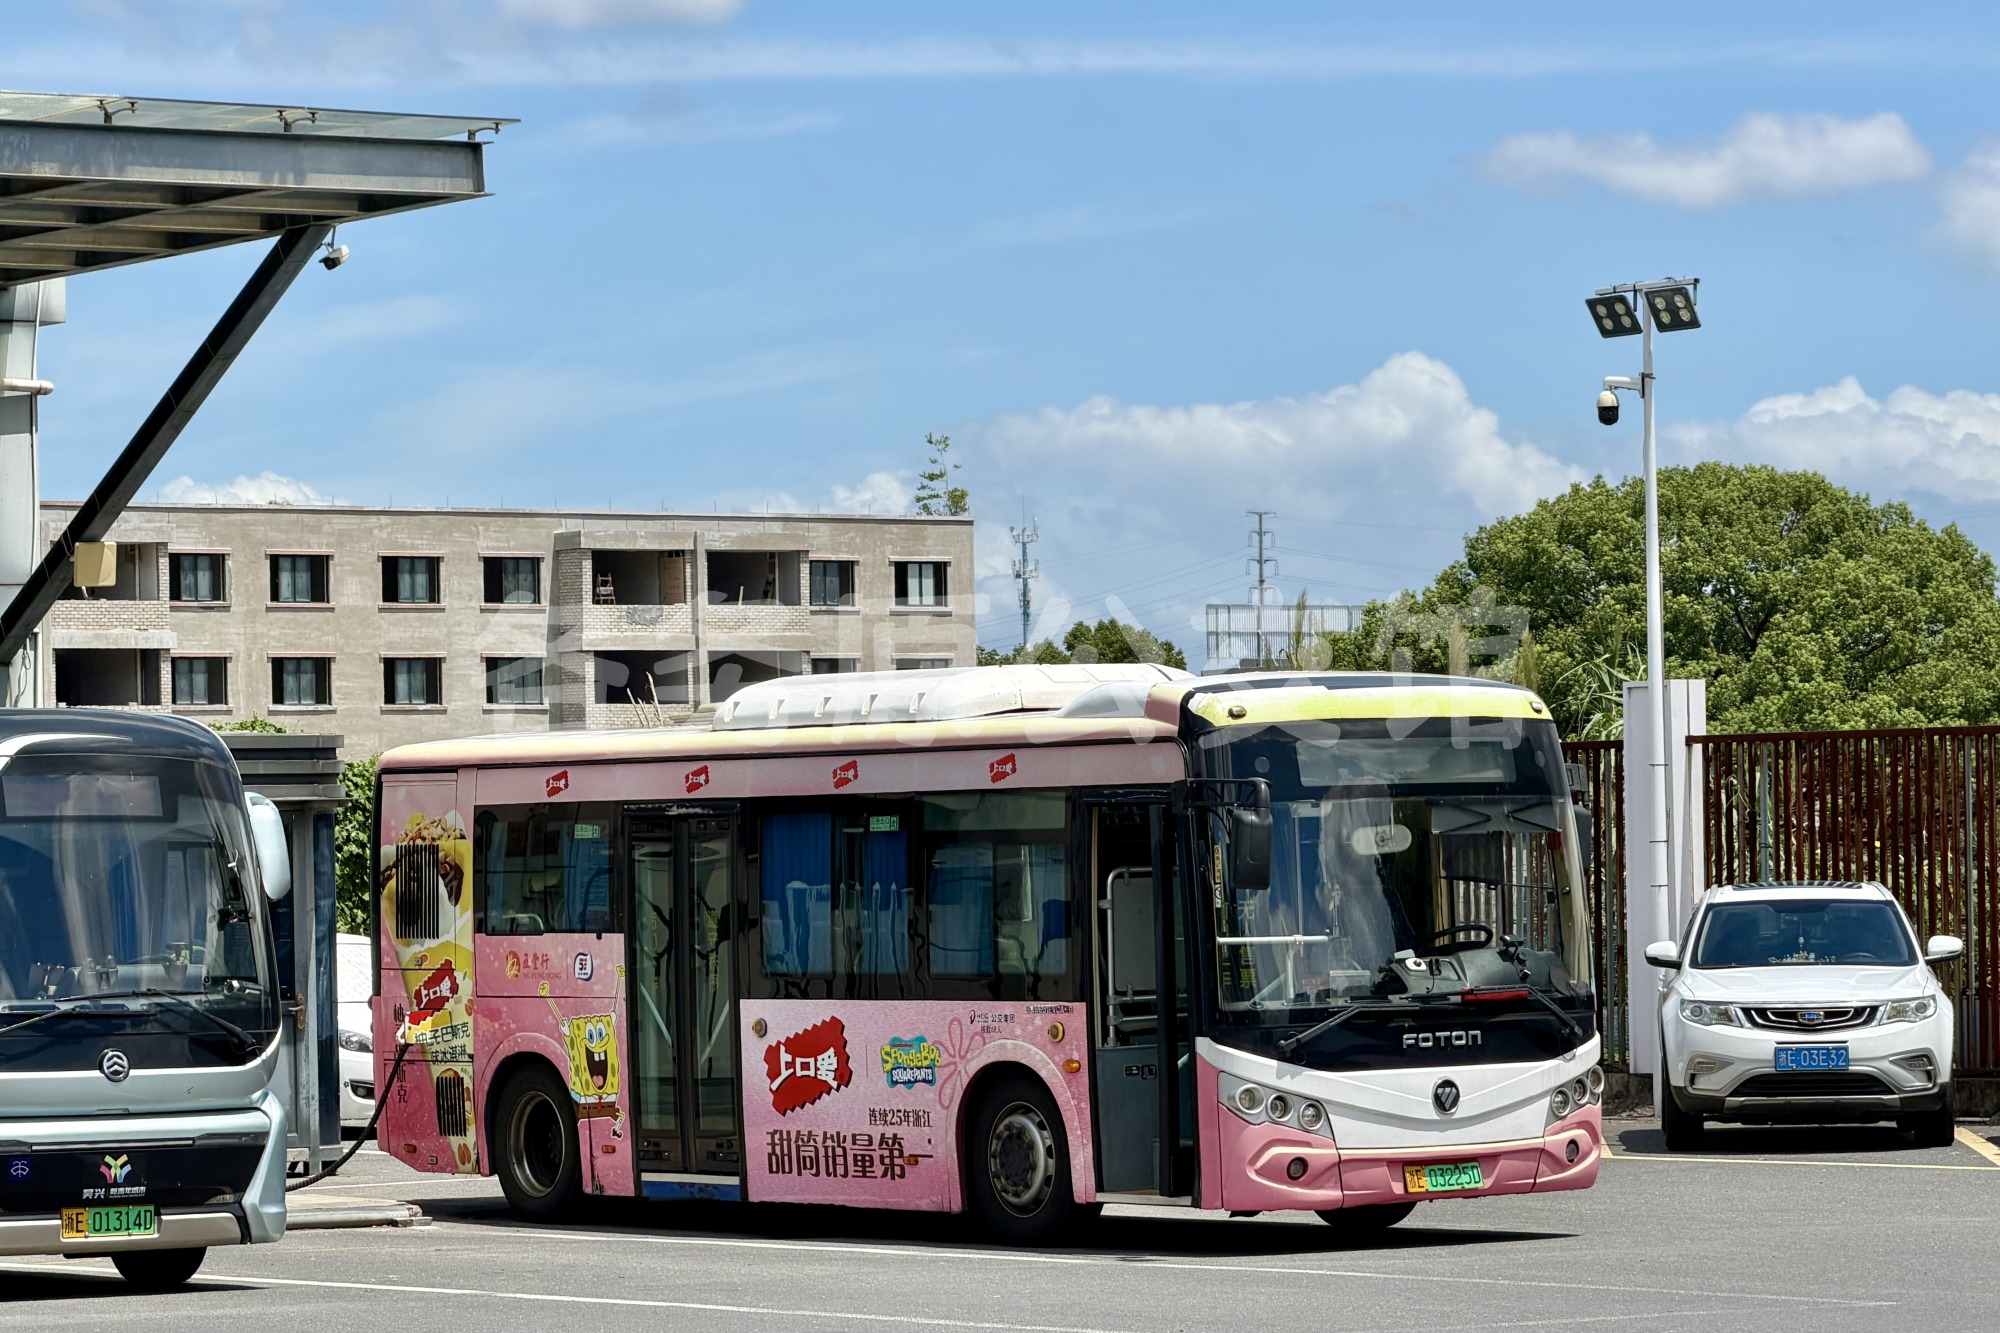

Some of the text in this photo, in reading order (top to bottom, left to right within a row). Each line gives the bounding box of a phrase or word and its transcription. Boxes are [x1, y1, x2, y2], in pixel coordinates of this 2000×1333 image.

[1402, 1030, 1482, 1049] FOTON
[770, 1045, 839, 1091] 上口爱
[892, 1068, 933, 1083] SQUAREPANTS
[868, 1107, 933, 1128] 连续25年浙江
[766, 1129, 934, 1181] 甜筒销量第一
